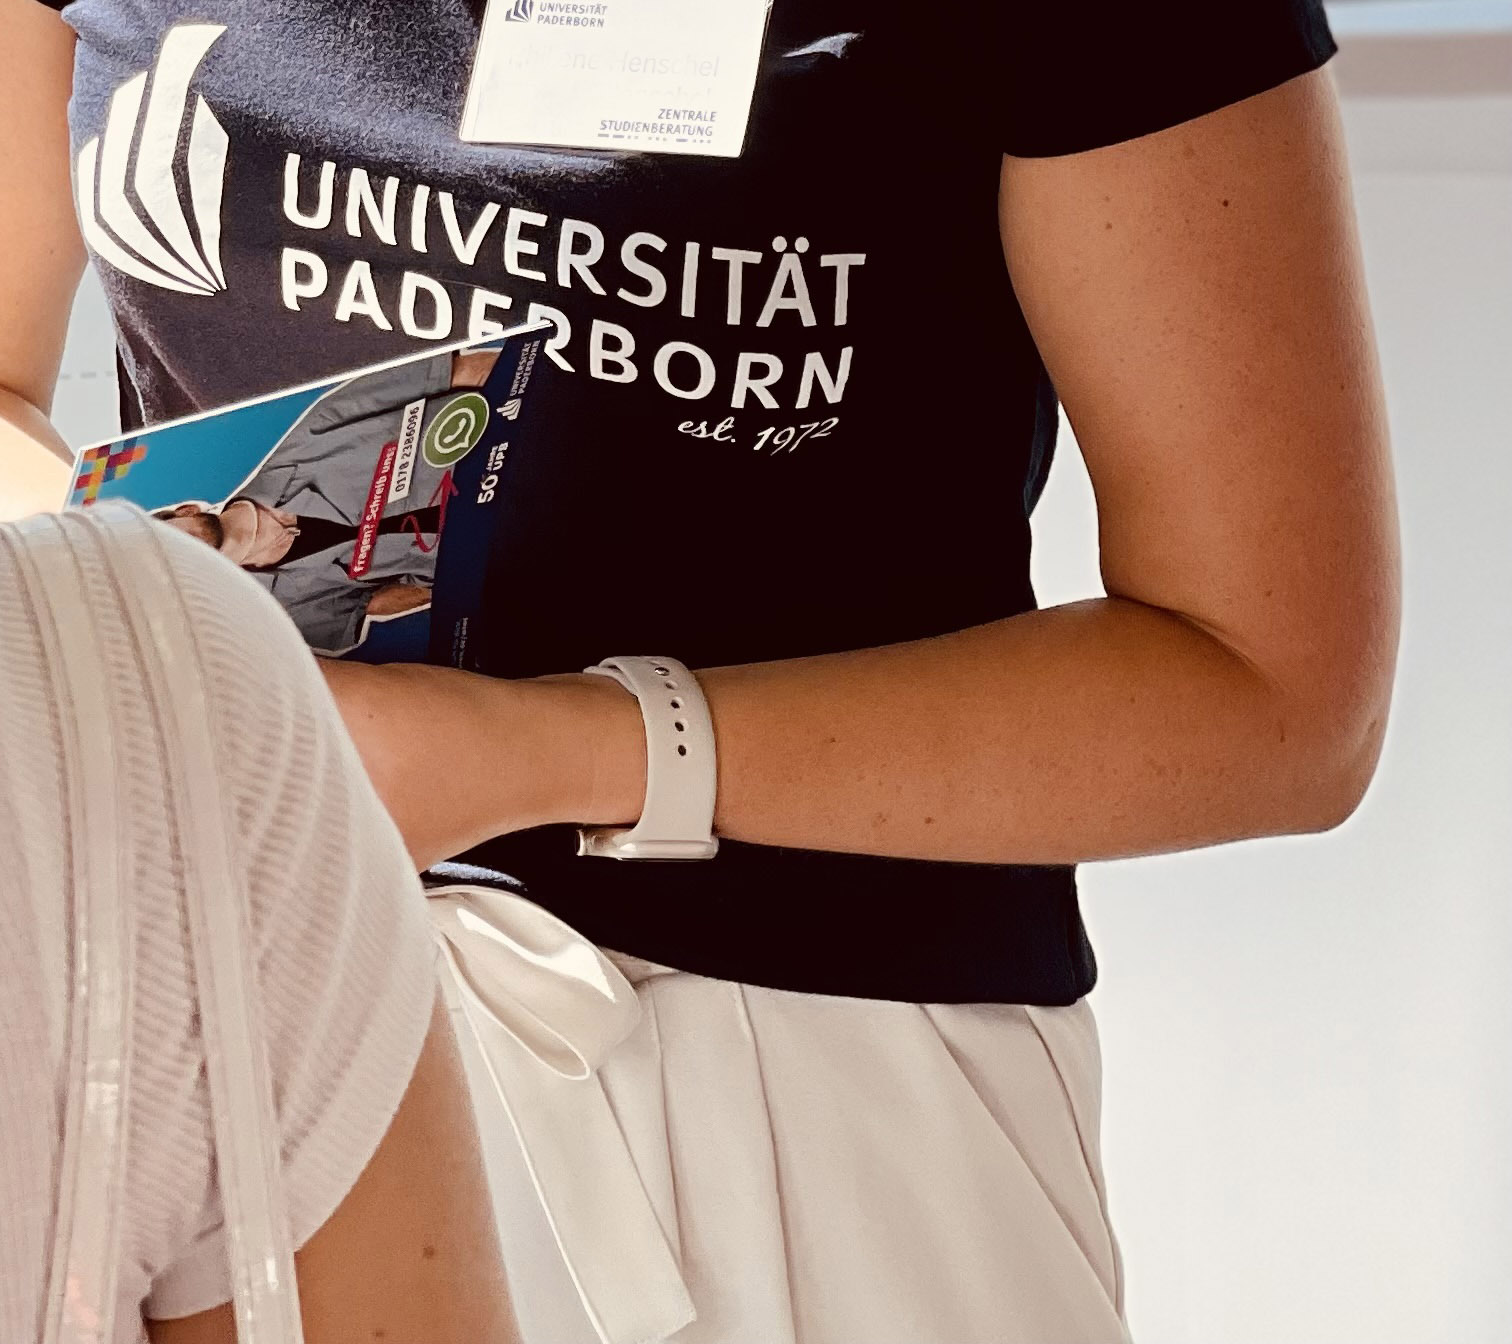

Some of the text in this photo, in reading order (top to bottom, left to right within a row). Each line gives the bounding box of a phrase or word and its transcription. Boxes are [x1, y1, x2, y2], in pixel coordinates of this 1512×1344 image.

[537, 14, 605, 28] PADERBORN
[539, 1, 608, 15] UNIVERSITÄT
[599, 119, 714, 137] STUDIENBERATUNG
[658, 108, 717, 123] ZENTRALE
[282, 153, 867, 328] UNIVERSITÄT
[281, 246, 853, 410] PADERBORN
[395, 406, 420, 493] 0178 2386096
[677, 416, 839, 456] est. 1972
[493, 441, 509, 471] UPB
